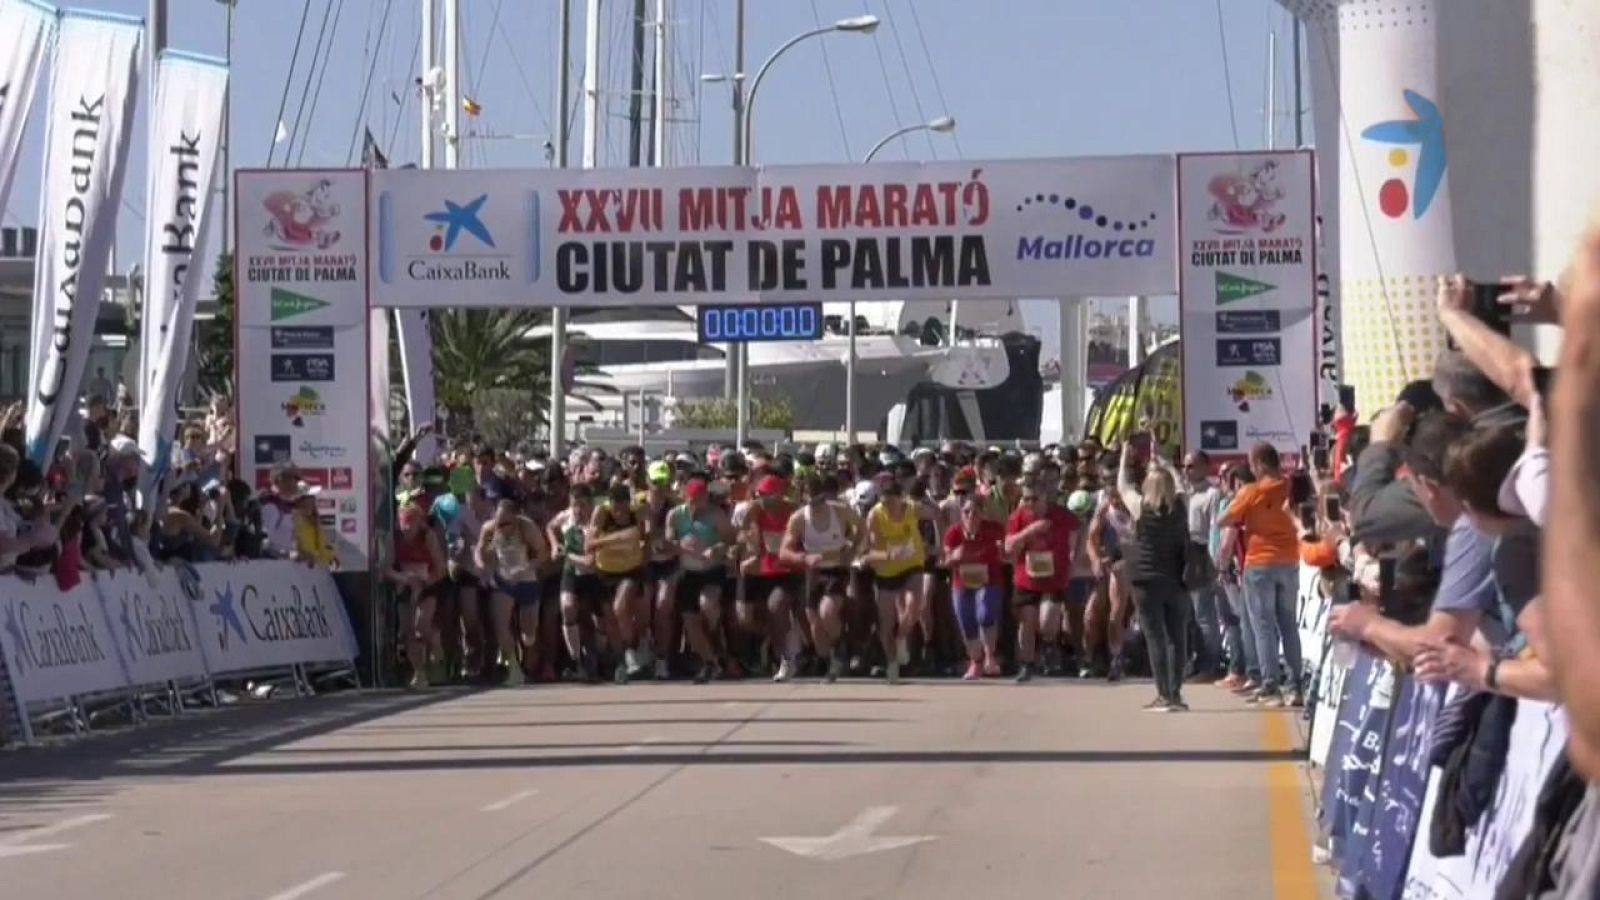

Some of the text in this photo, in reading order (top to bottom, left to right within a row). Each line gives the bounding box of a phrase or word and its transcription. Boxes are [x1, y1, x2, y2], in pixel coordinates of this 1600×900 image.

[557, 168, 990, 233] XXVII MITJA MARATÓ
[1016, 234, 1155, 261] Mallorca
[1191, 249, 1303, 267] CIUTAT DE PALMA
[247, 267, 357, 282] CIUTAT DE PALMA
[407, 260, 511, 281] CaixaBank
[555, 234, 992, 294] CIUTAT DE PALMA
[240, 584, 333, 642] CaixaBank
